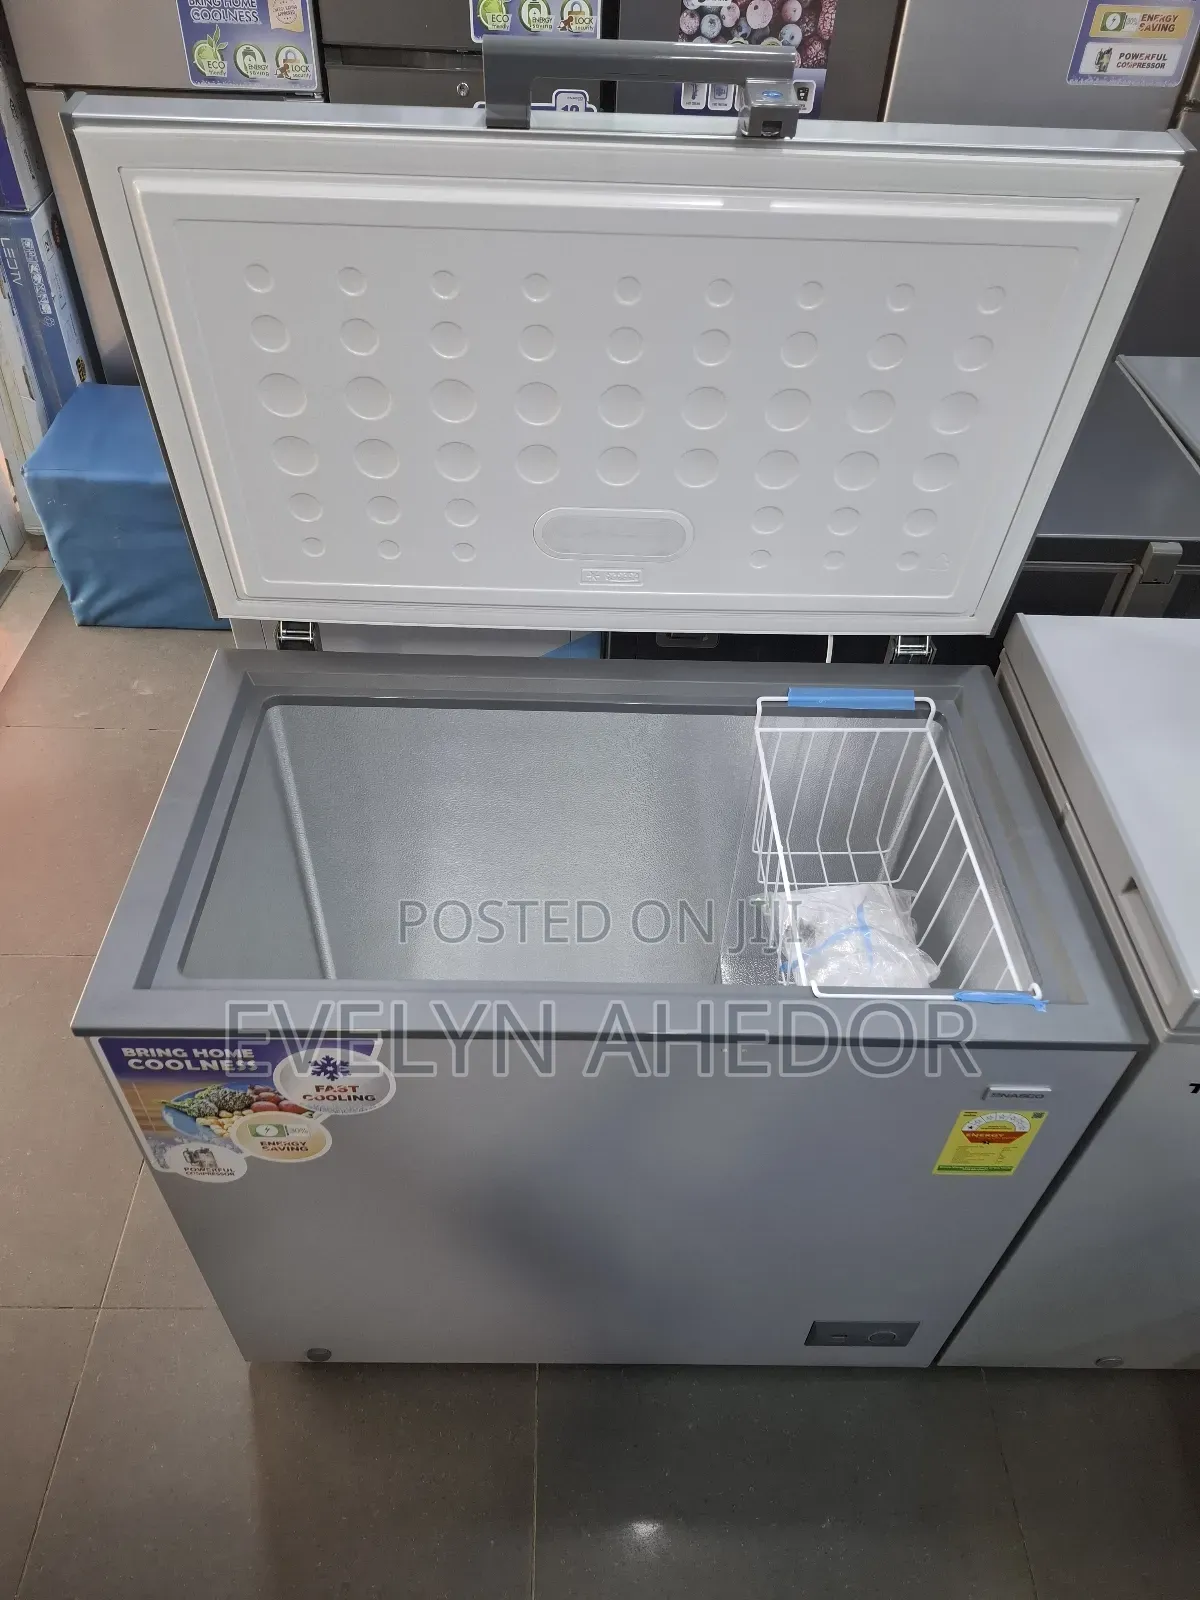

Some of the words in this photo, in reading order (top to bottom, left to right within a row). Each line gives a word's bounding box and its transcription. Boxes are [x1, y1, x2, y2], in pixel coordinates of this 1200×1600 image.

[224, 0, 257, 8] HOME
[191, 7, 259, 22] COOLNESS
[491, 14, 509, 23] ECO
[1141, 14, 1179, 23] ENERGY
[575, 17, 594, 25] LOCK
[1139, 23, 1175, 32] SAVING
[1119, 52, 1168, 61] POWERFUL
[207, 61, 226, 69] ECO
[121, 1047, 188, 1058] BRING
[192, 1048, 255, 1058] HOME
[127, 1058, 258, 1070] COOLNESS
[314, 1085, 359, 1093] FAST
